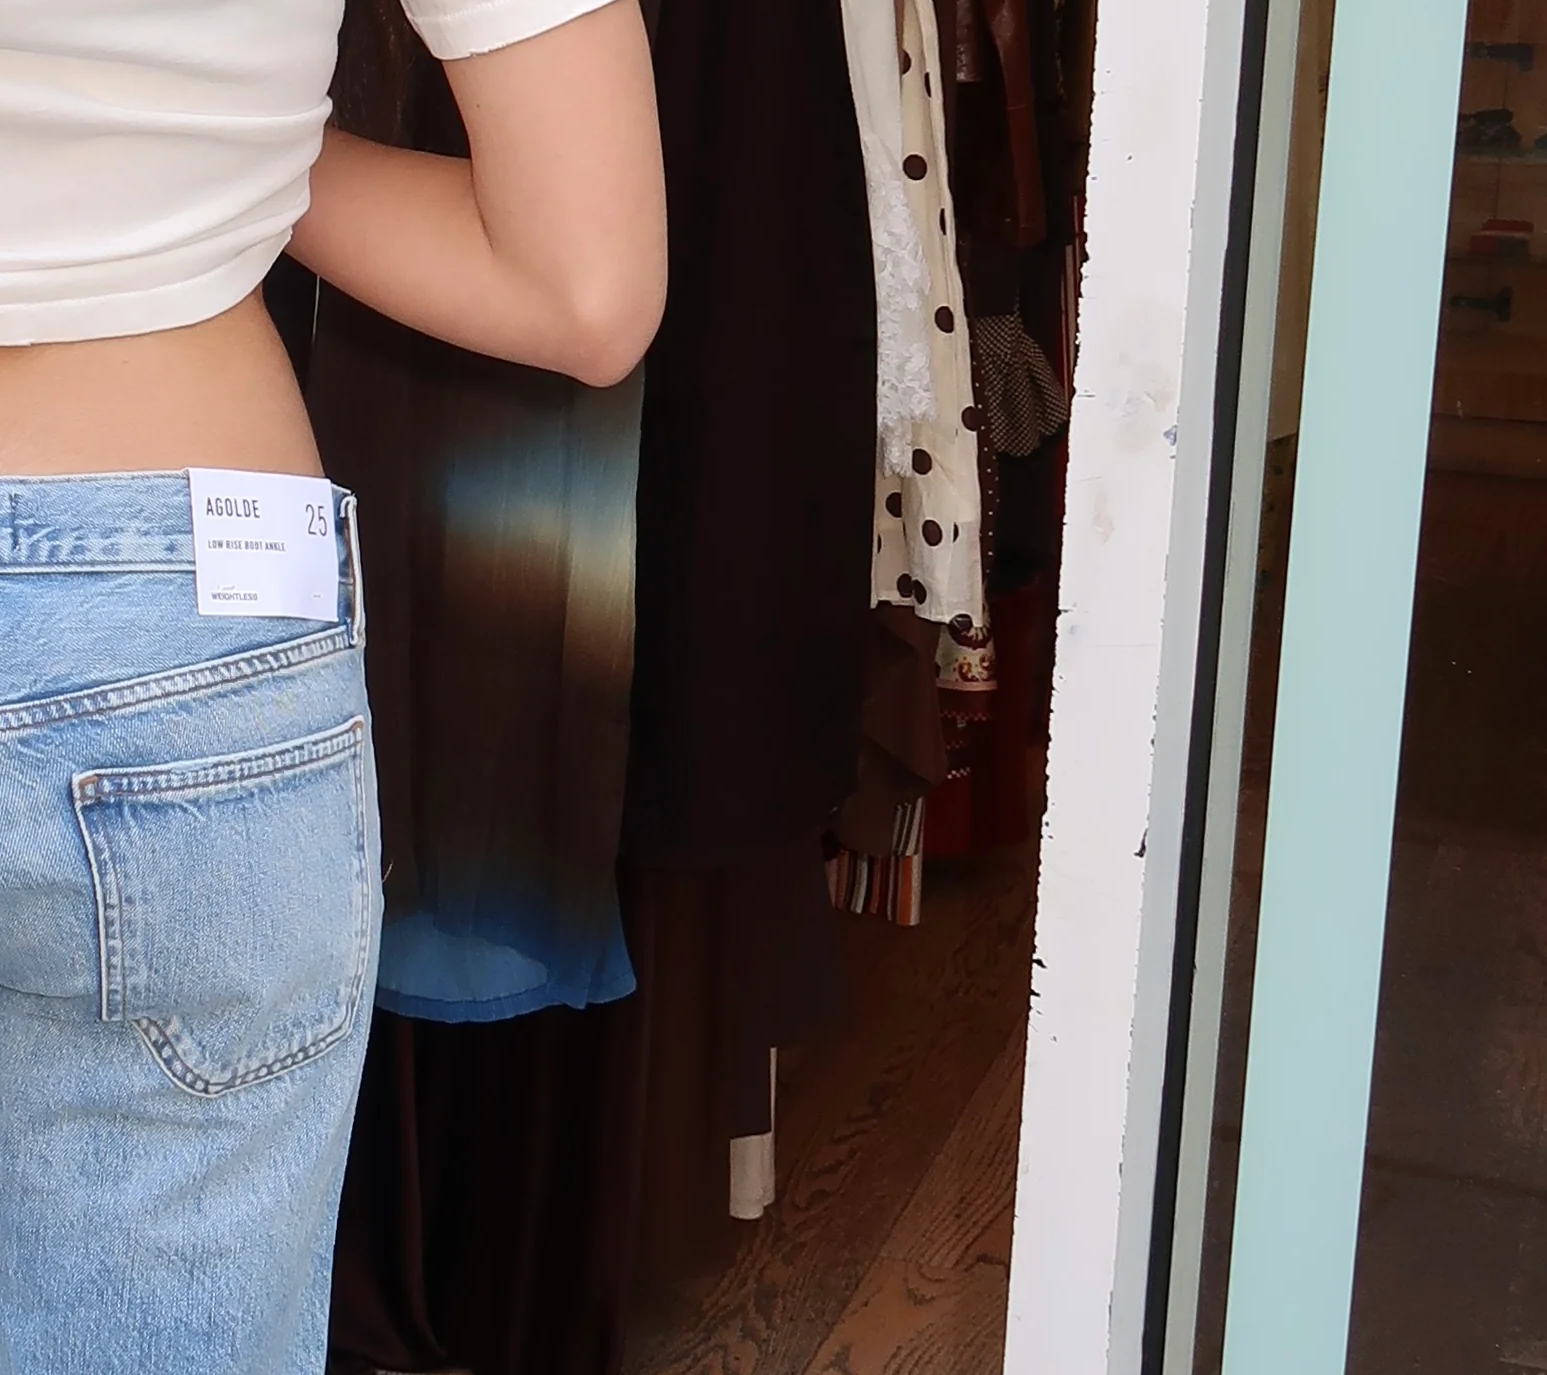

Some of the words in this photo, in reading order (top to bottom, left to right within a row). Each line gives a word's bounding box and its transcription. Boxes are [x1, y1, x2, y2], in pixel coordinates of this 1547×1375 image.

[206, 497, 260, 518] AGOLDE
[305, 504, 327, 536] 25
[208, 540, 224, 549] LOW
[226, 540, 242, 550] RISE
[245, 541, 263, 550] BOOT
